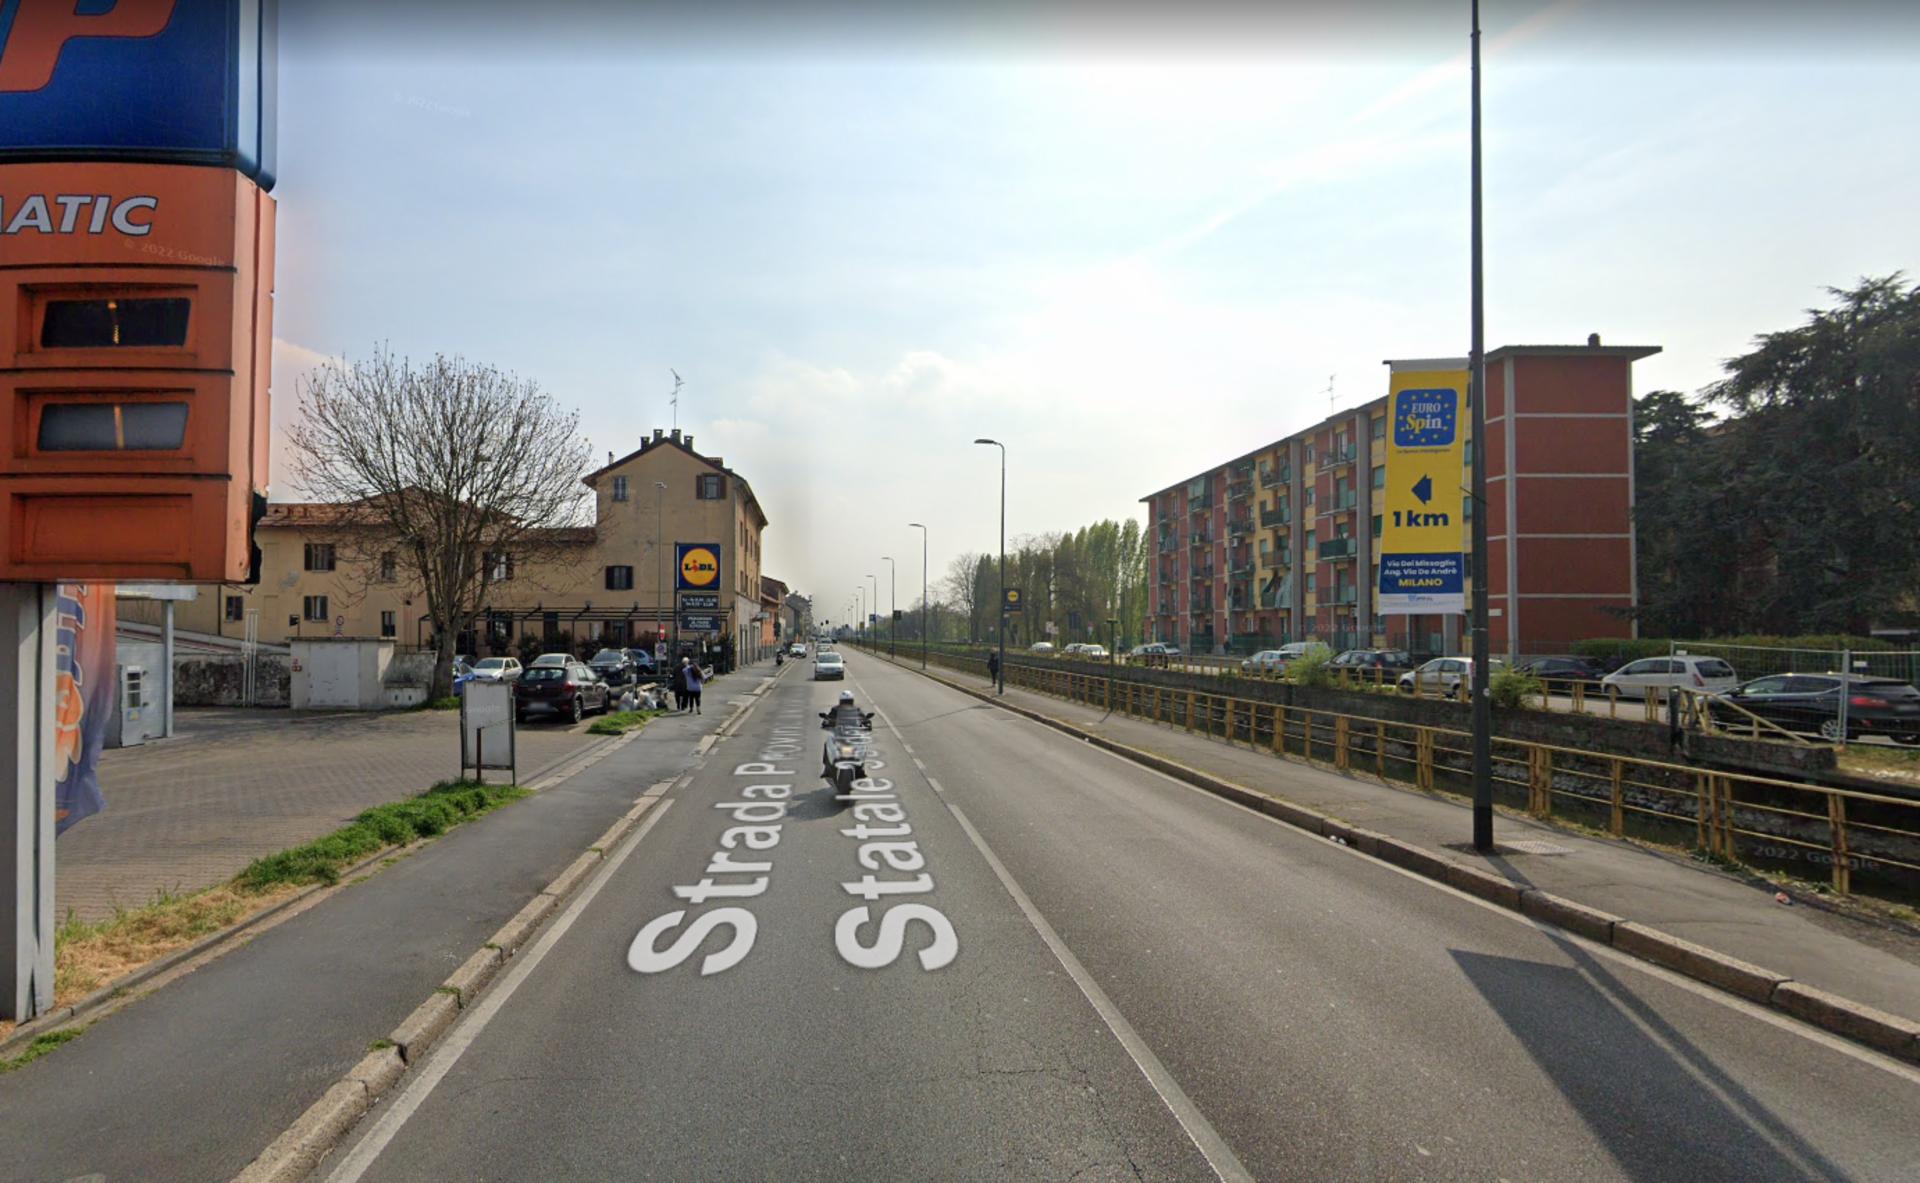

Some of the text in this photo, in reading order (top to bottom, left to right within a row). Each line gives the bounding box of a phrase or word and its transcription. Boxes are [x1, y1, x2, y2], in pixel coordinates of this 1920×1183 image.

[0, 194, 158, 236] ATIC
[1411, 402, 1441, 413] EURO
[1406, 413, 1442, 434] Spin
[1393, 510, 1449, 527] 1 km
[1386, 559, 1400, 567] Via
[1399, 579, 1443, 587] MILANO
